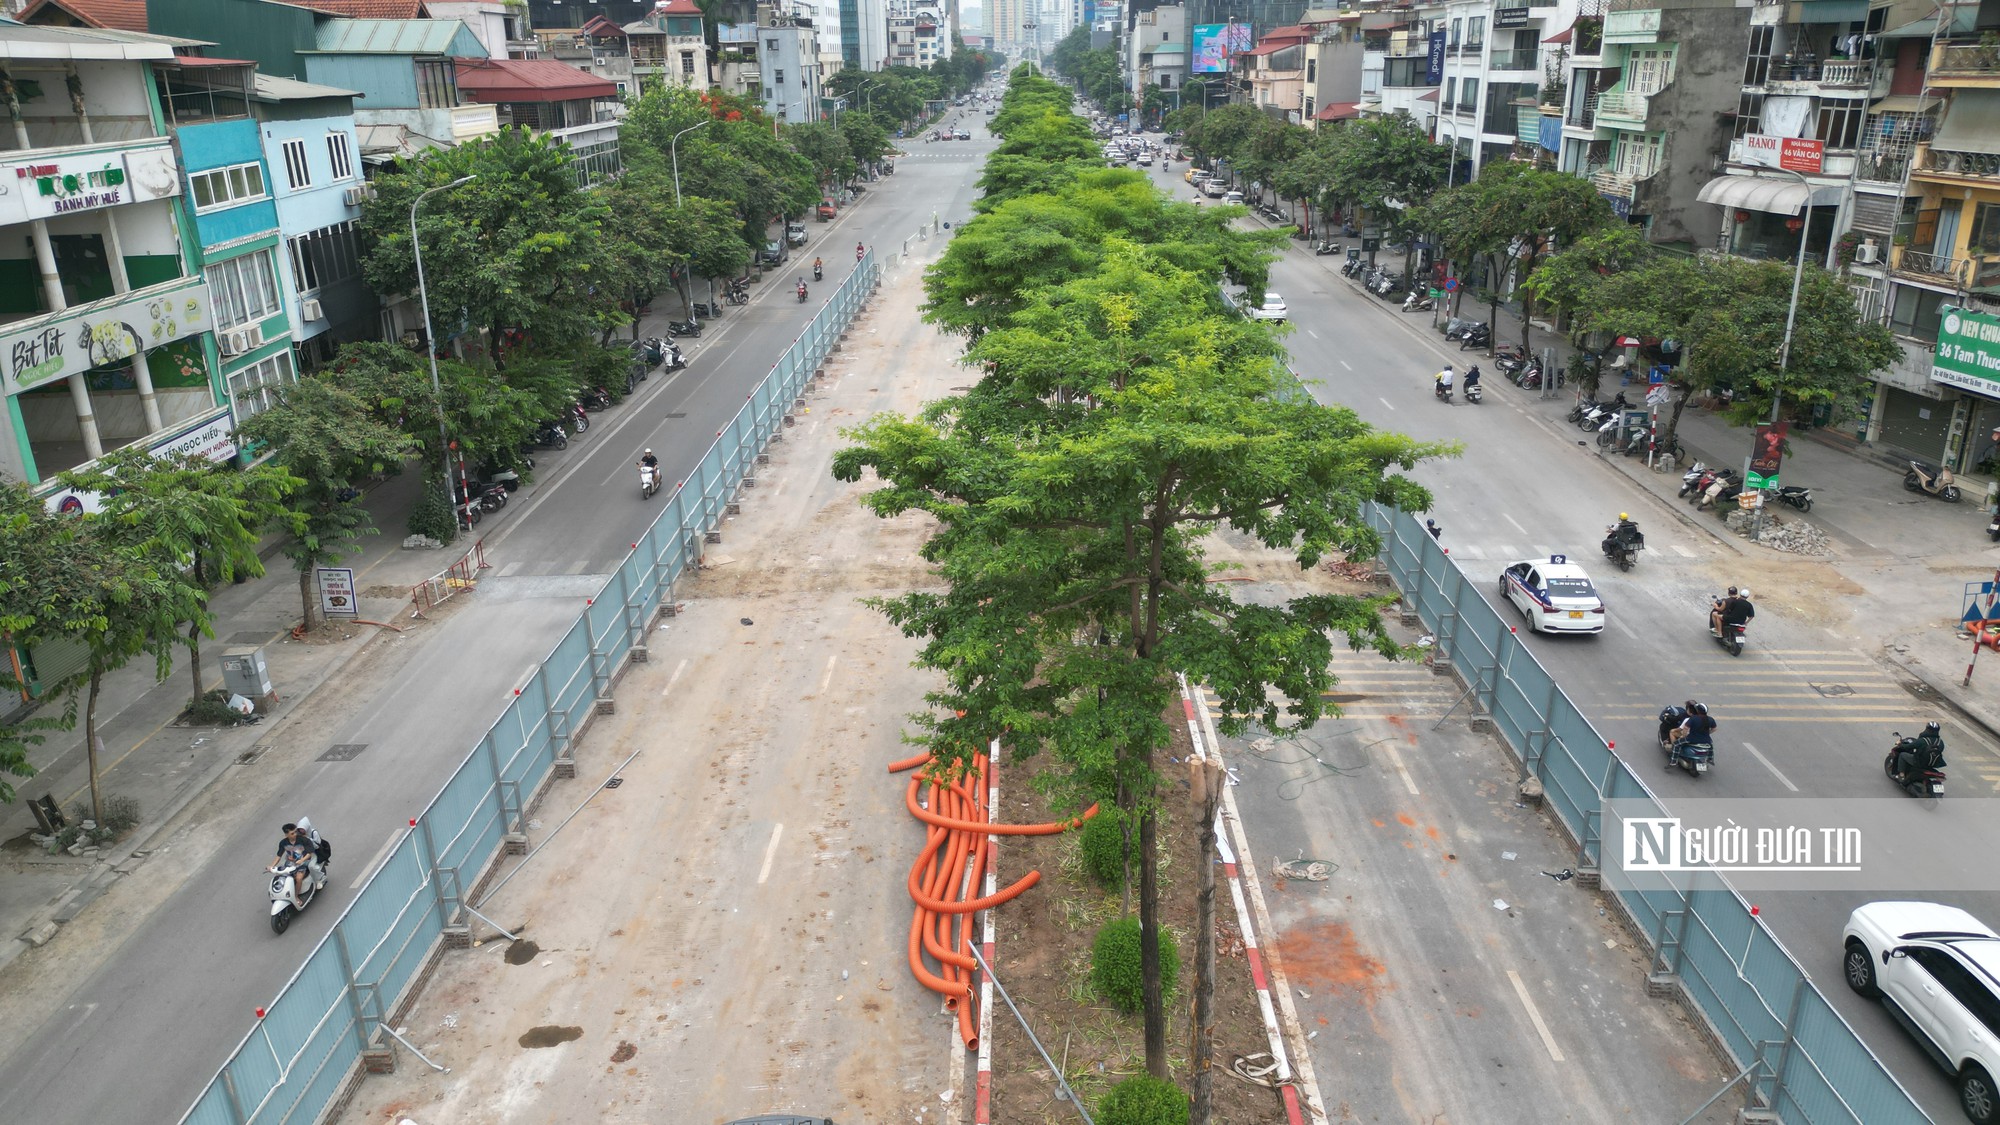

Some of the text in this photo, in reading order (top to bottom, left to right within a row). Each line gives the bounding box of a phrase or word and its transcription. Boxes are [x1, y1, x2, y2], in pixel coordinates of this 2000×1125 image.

[1748, 136, 1776, 150] HANOI
[1783, 148, 1792, 157] 46
[1806, 151, 1820, 160] CAO
[1960, 319, 1980, 339] NEM
[1939, 342, 1952, 358] 36
[202, 426, 218, 443] HIẾU
